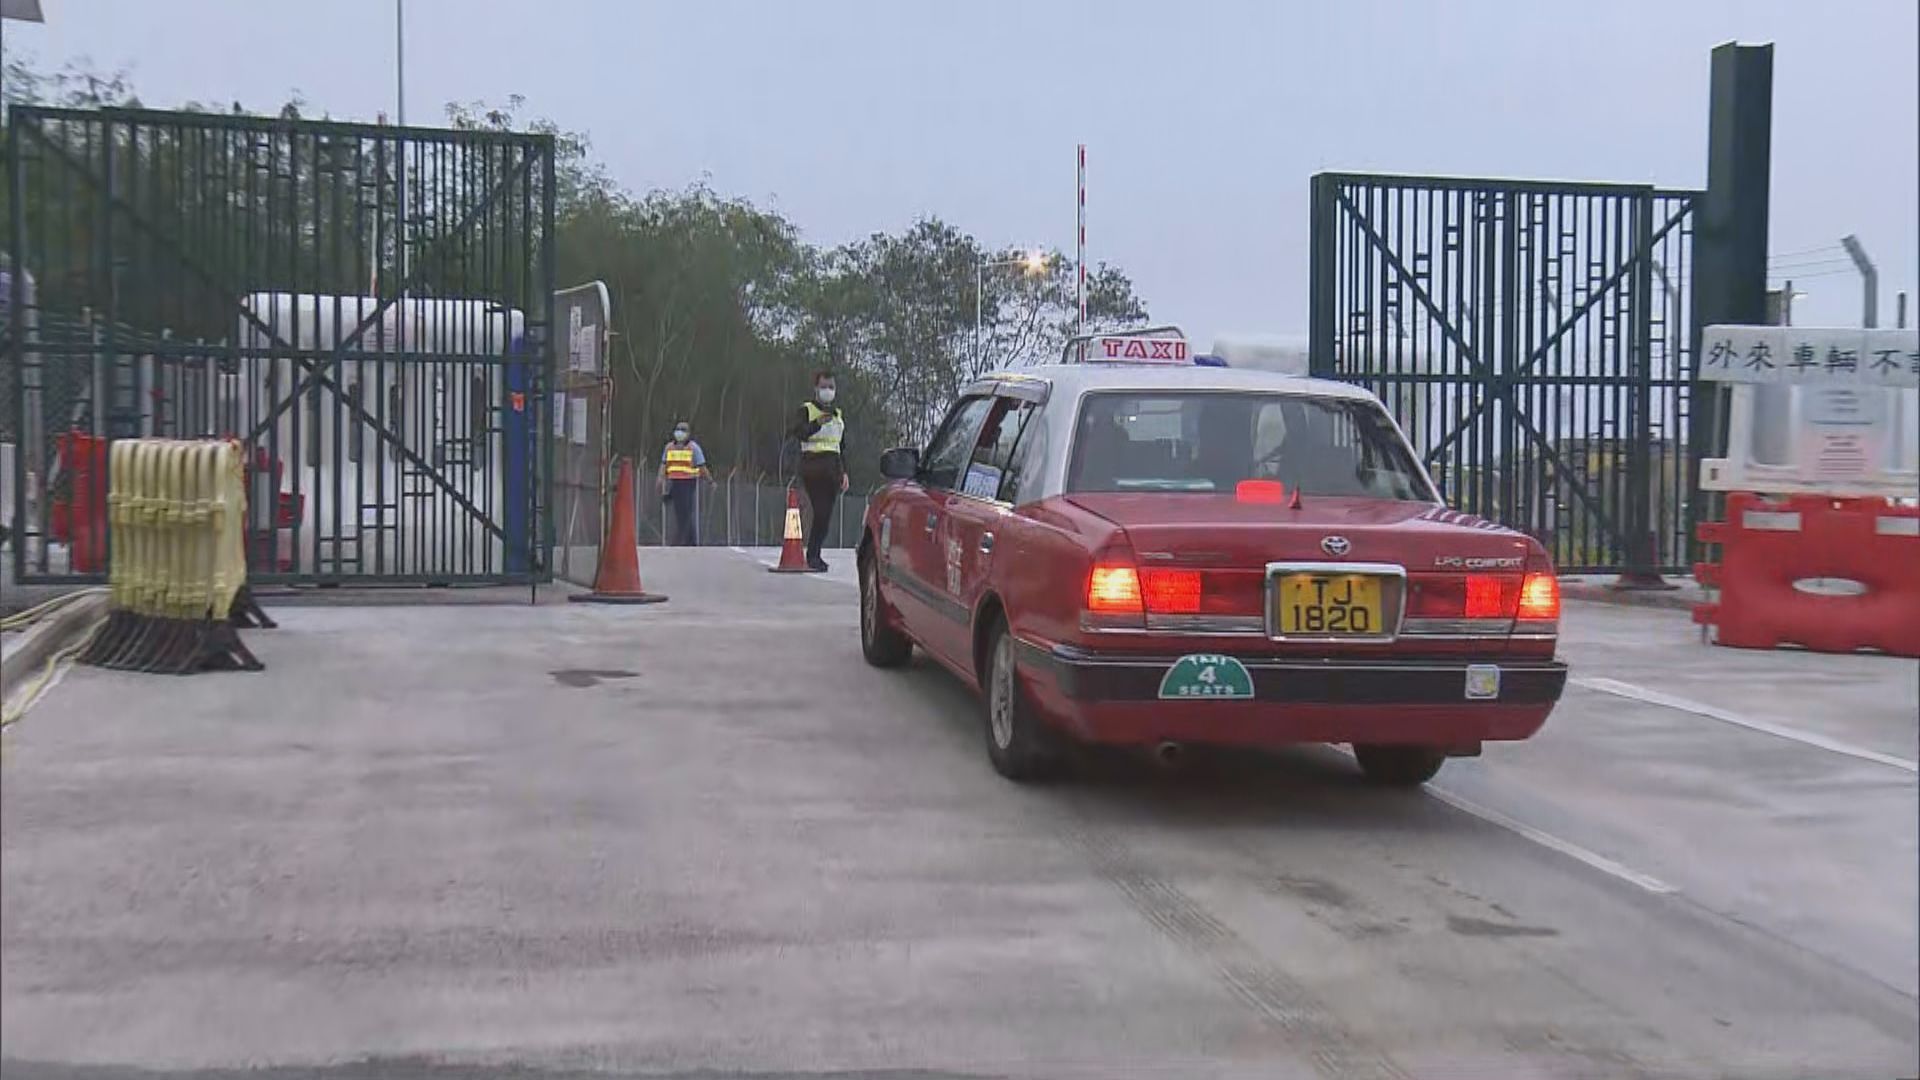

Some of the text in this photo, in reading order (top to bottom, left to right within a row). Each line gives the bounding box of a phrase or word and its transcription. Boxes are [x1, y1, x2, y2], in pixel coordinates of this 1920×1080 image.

[1102, 338, 1186, 360] TAXI
[1310, 579, 1353, 606] TJ
[1293, 605, 1370, 632] 1820
[1198, 666, 1217, 683] 4
[1178, 685, 1235, 696] SEATS
